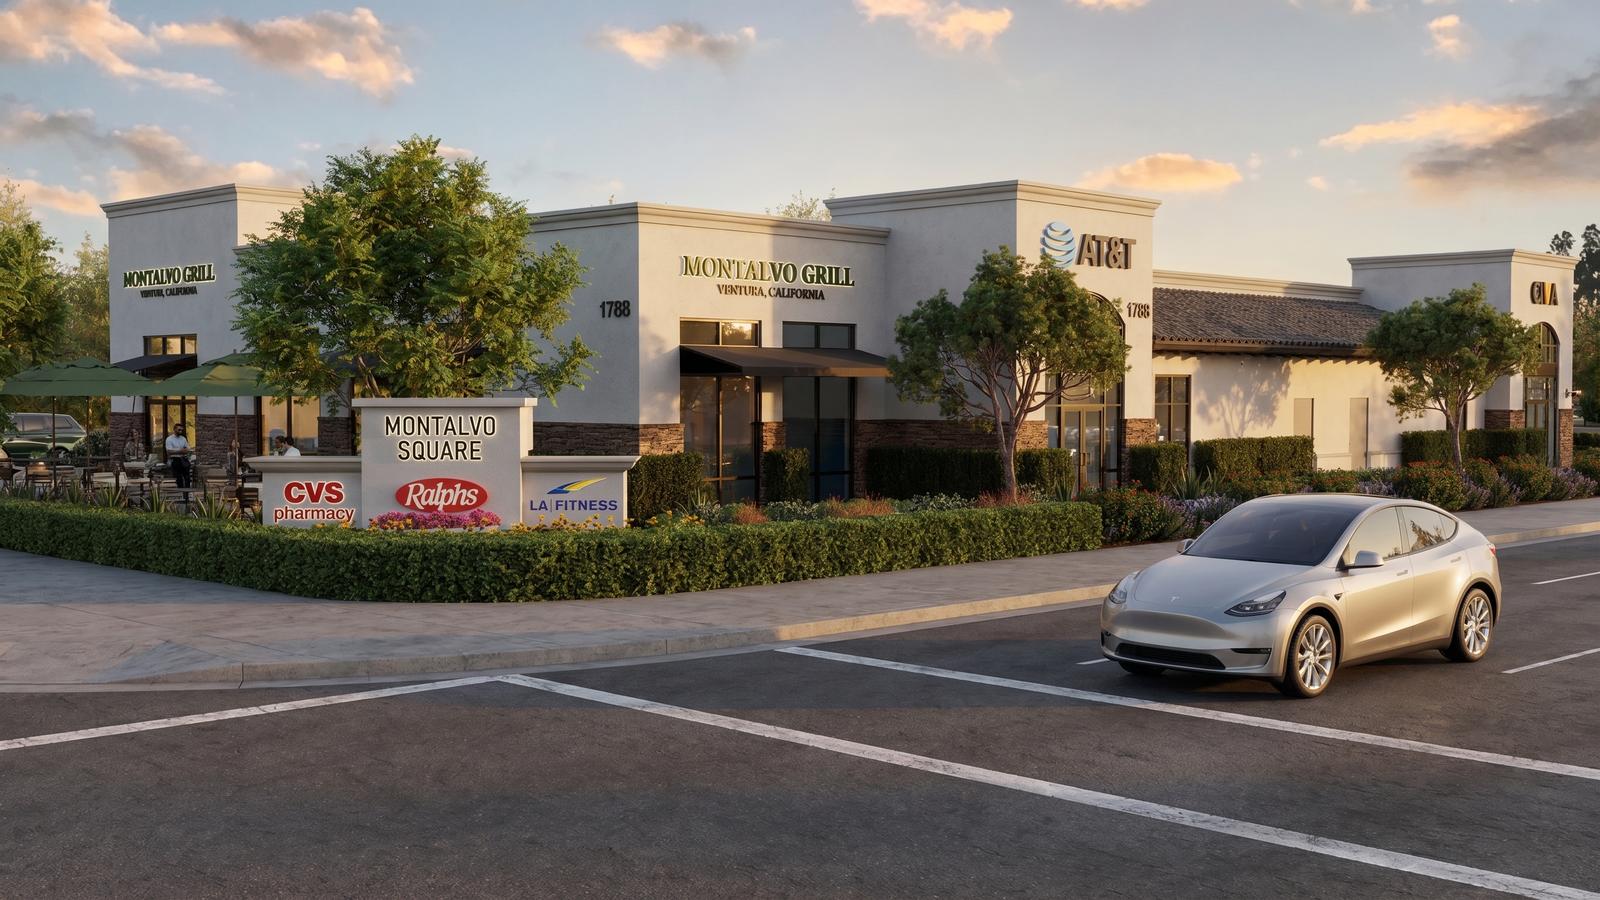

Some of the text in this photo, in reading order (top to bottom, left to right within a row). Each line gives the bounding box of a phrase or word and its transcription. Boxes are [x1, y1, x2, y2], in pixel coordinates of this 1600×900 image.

[1075, 233, 1137, 270] AT&T
[123, 263, 216, 288] MONTALVO GRILL
[682, 255, 855, 287] MONTALVO GRILL
[717, 284, 826, 301] VENTURA, CALIFORNIA
[600, 300, 631, 318] 1788
[1126, 302, 1150, 319] 1788
[385, 415, 496, 436] MONTALVO
[398, 440, 482, 461] SQUARE
[284, 481, 344, 504] CVS
[404, 481, 479, 512] Ralphs
[274, 505, 355, 523] pharmacy
[529, 500, 618, 511] LA FITNESS
